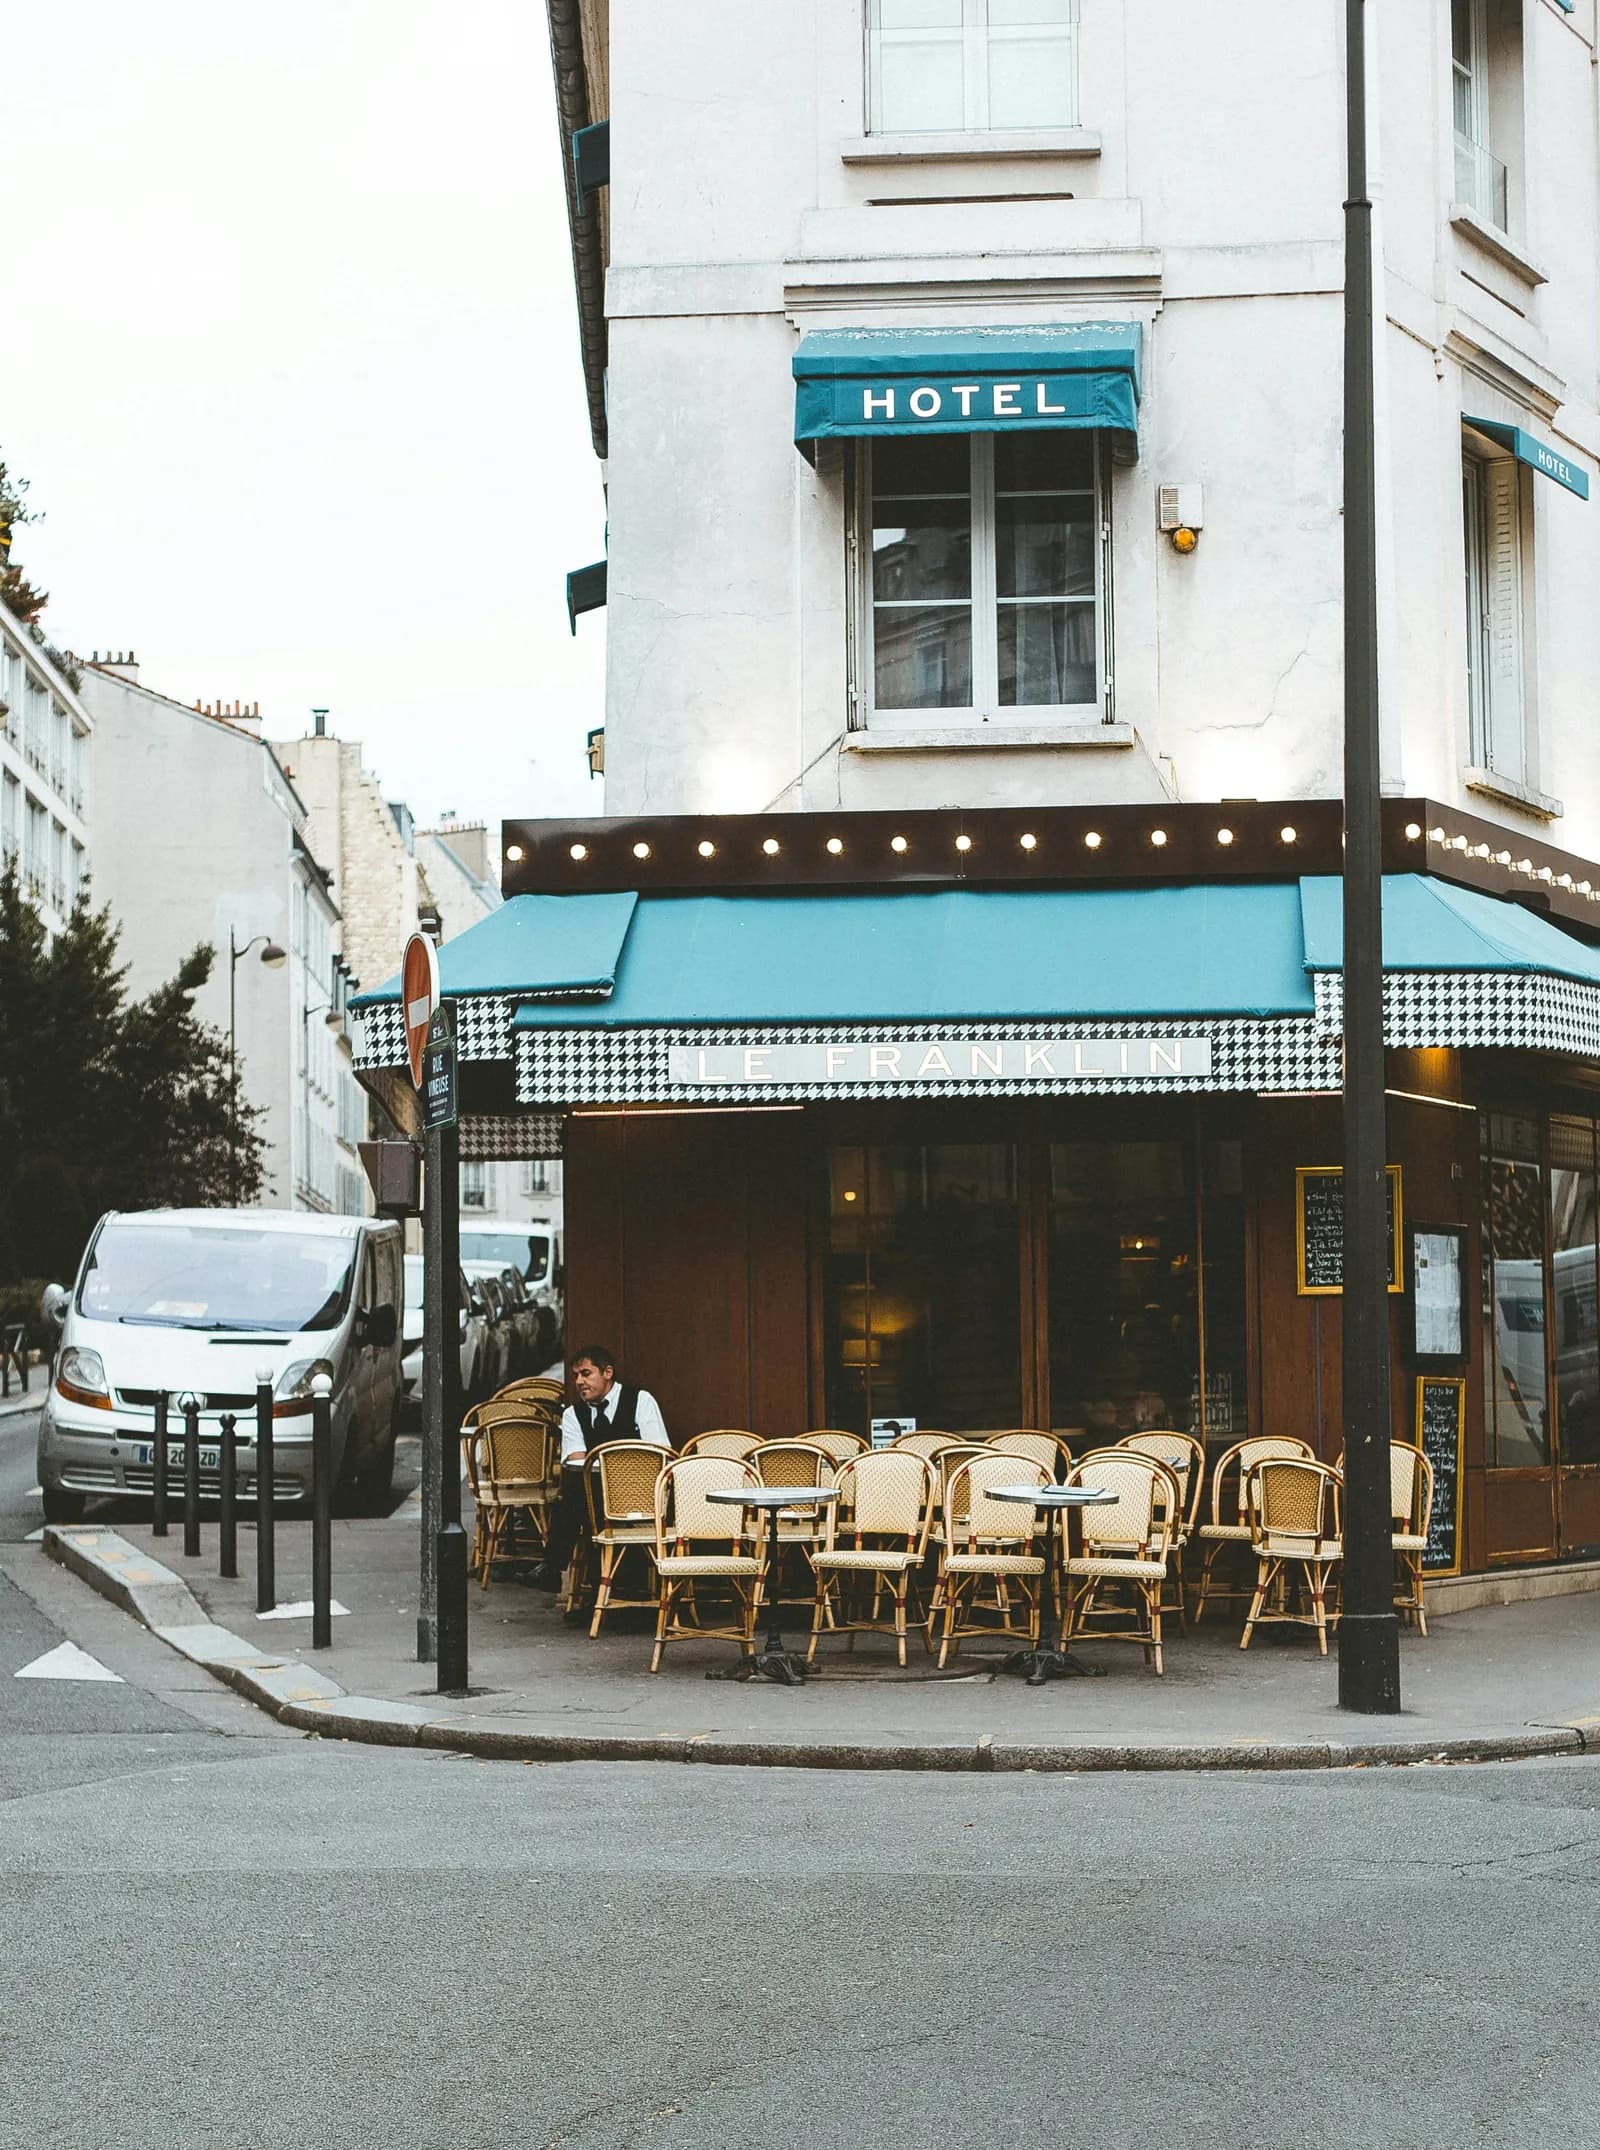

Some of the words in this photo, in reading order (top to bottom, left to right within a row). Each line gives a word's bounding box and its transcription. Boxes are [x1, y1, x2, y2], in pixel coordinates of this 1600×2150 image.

[863, 383, 1066, 420] HOTEL
[1538, 448, 1572, 483] HOTEL
[432, 1054, 444, 1074] RUE
[698, 1048, 773, 1082] LE
[826, 1041, 1183, 1080] FRANKLIN
